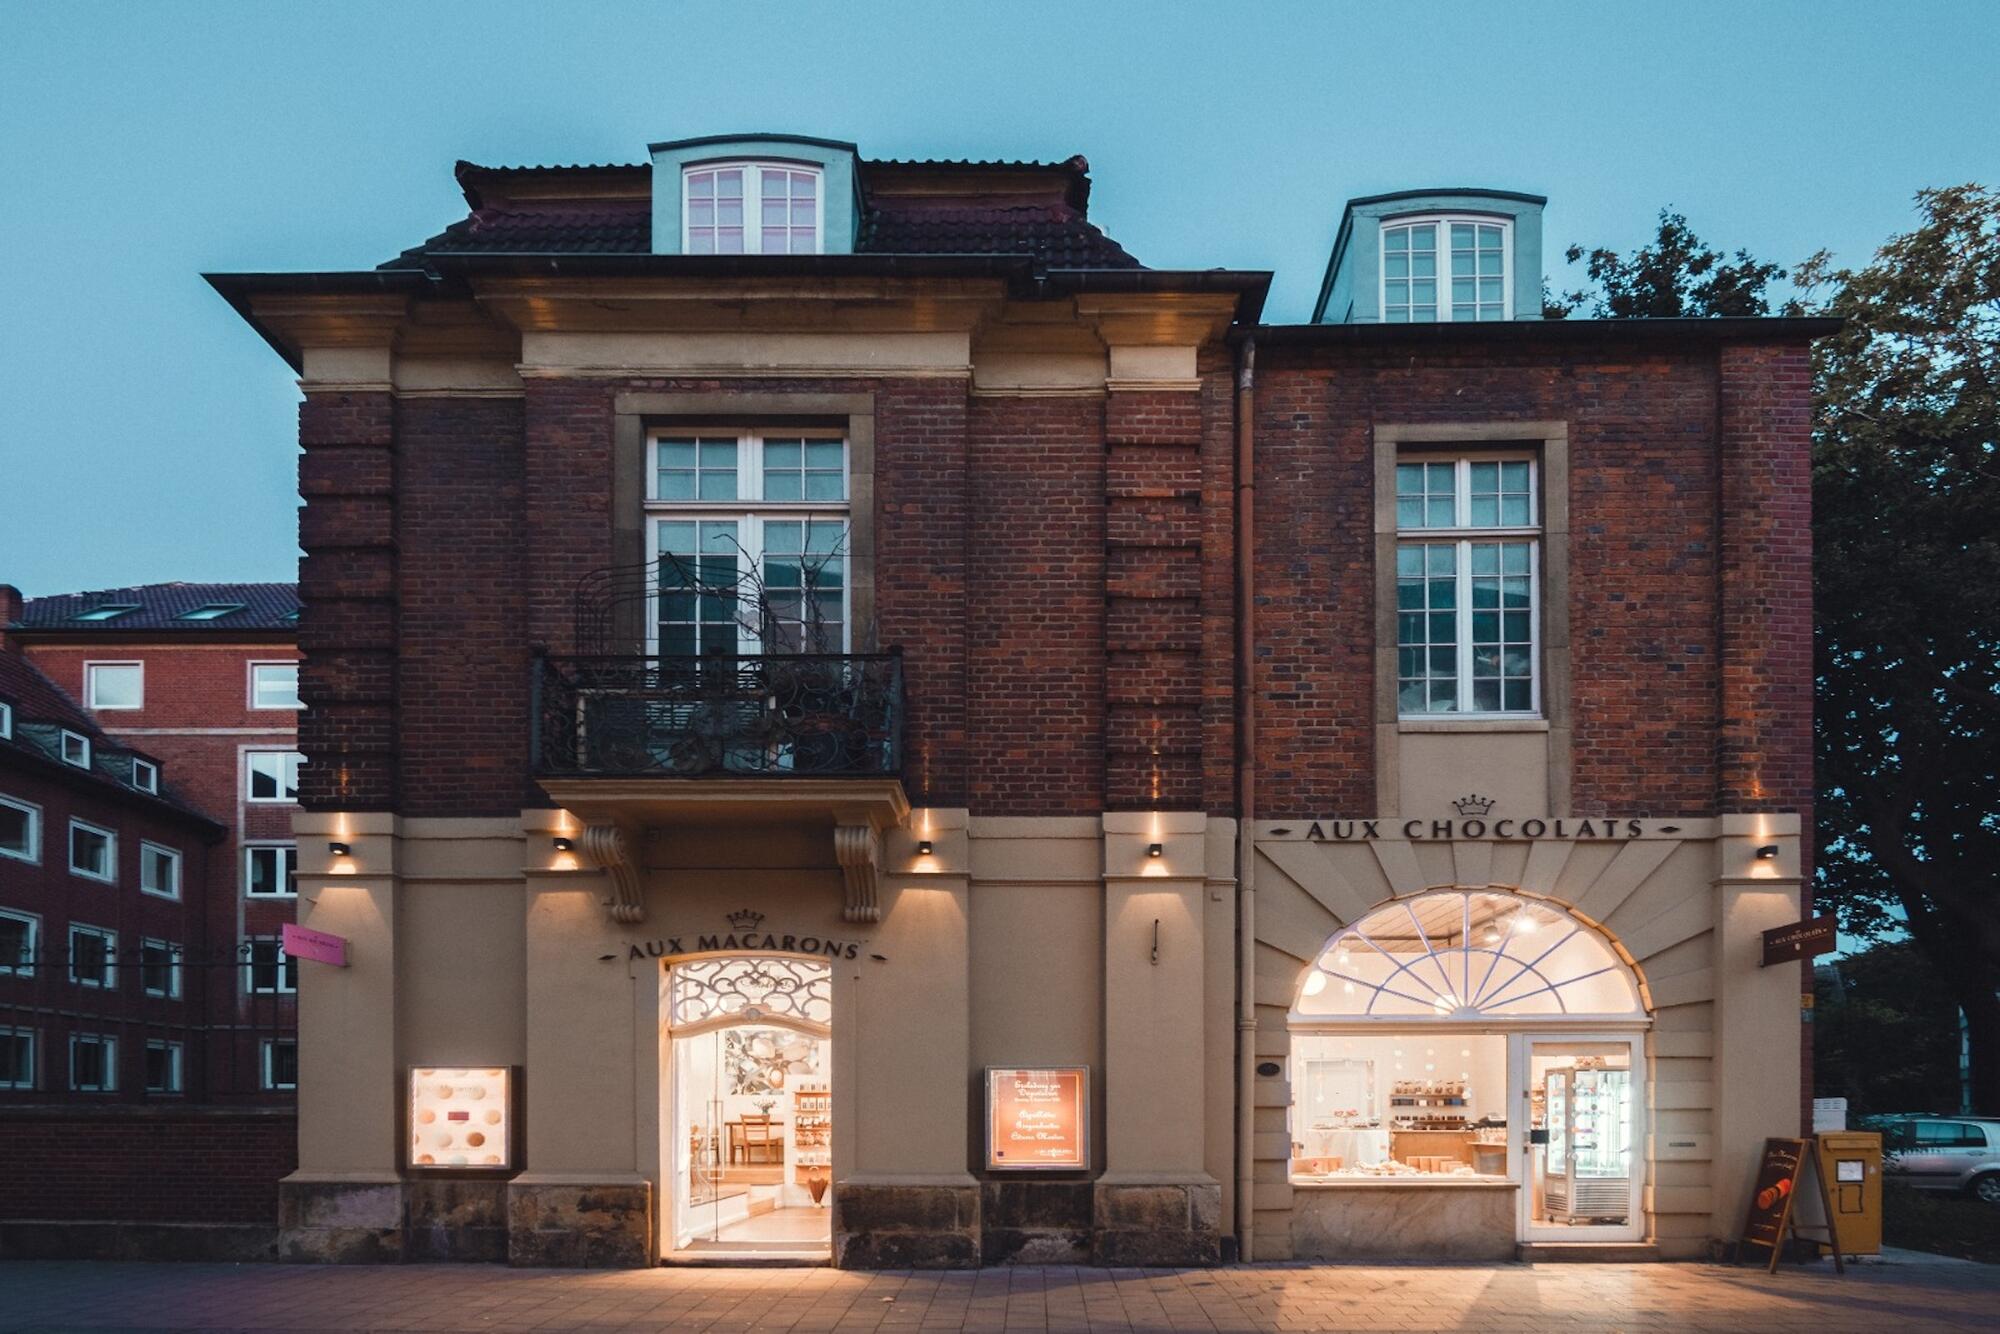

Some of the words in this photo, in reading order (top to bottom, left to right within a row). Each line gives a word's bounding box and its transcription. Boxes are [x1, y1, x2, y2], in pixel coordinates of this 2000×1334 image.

[1306, 820, 1380, 840] AUX
[1403, 818, 1643, 840] CHOCOLATS
[628, 938, 684, 960] AUX
[698, 933, 860, 961] MACARONS
